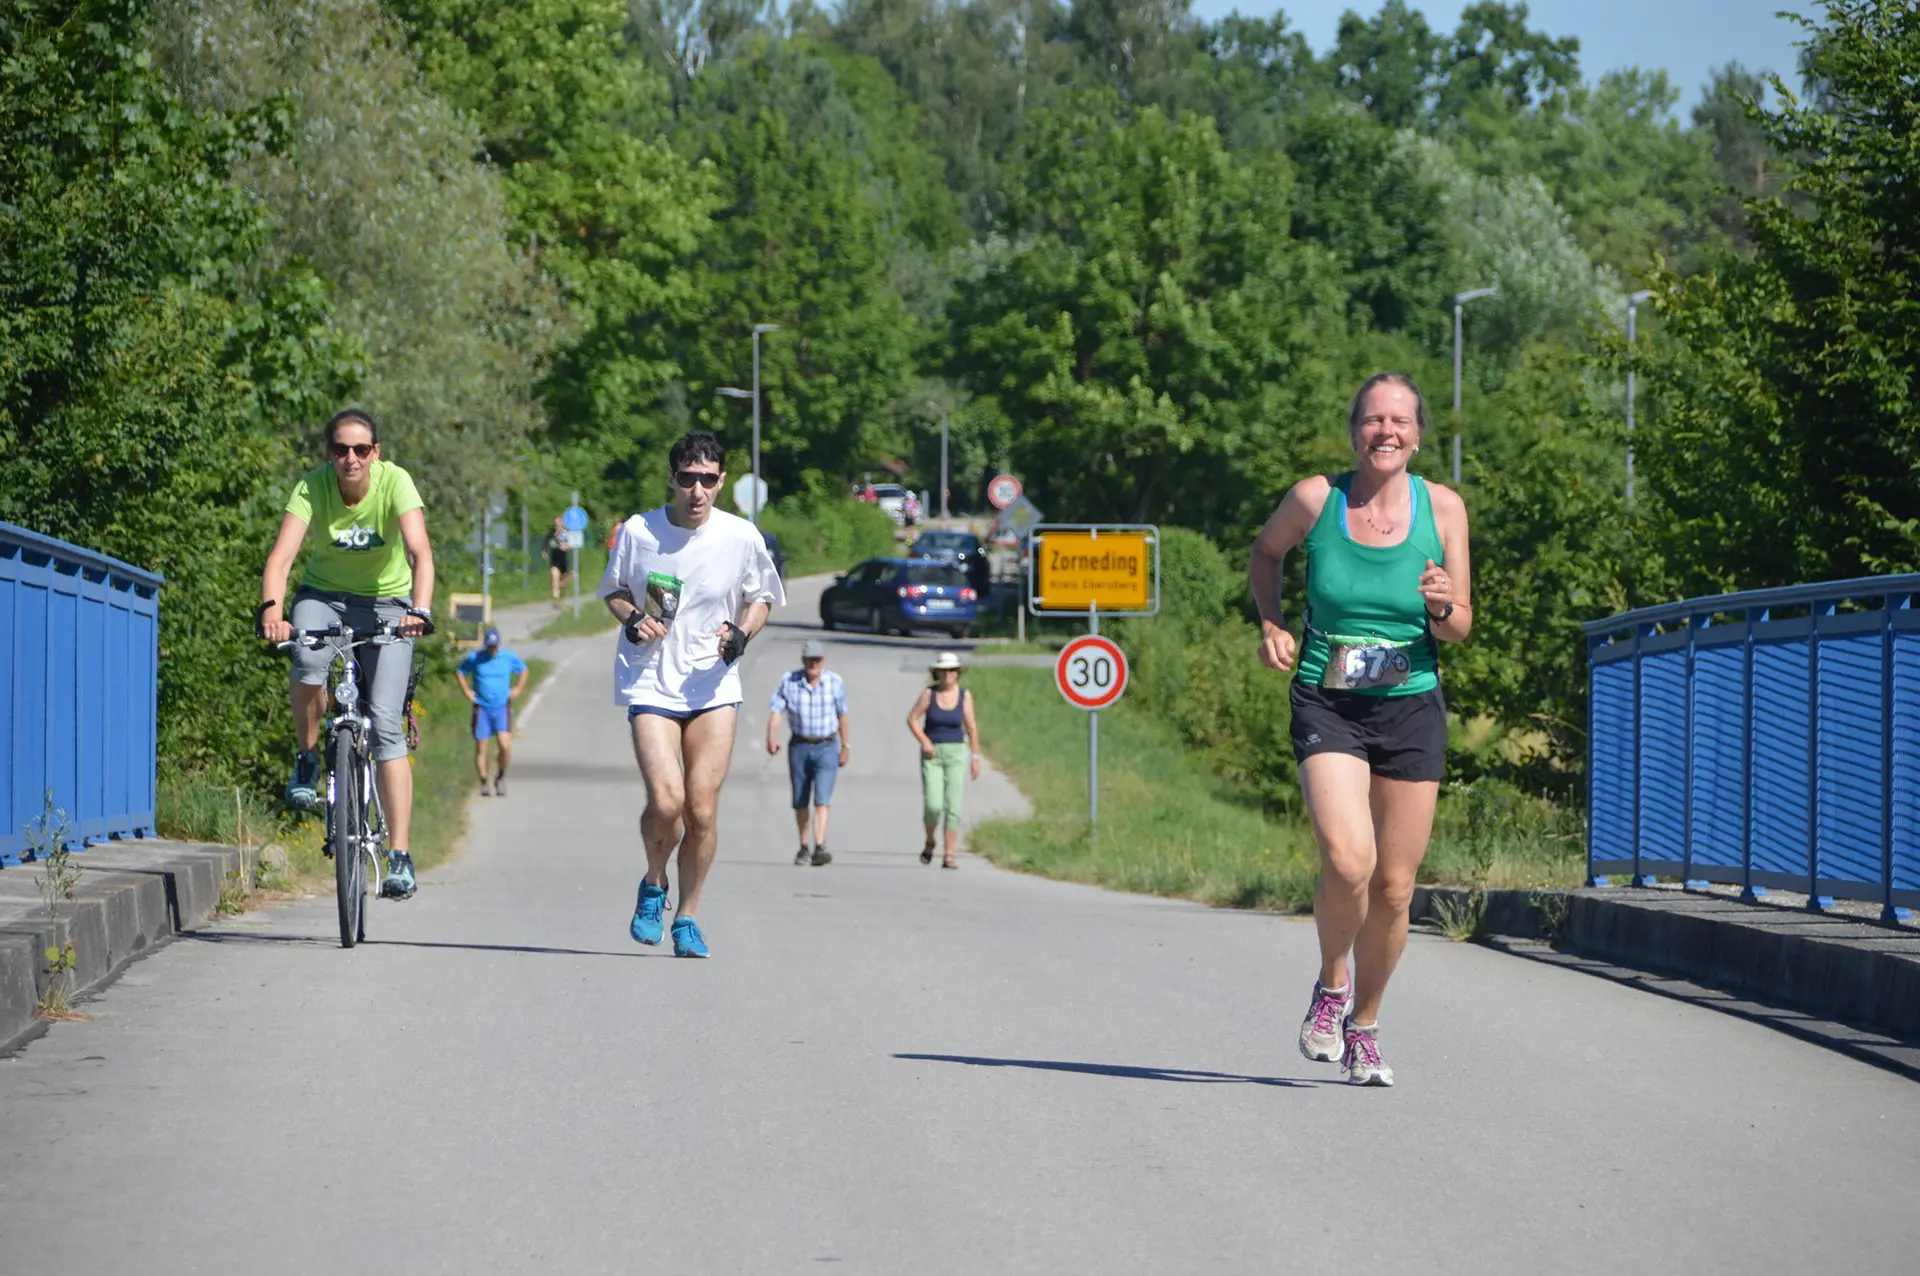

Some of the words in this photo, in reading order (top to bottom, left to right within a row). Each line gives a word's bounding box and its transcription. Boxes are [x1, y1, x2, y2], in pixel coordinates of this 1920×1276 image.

[1050, 549, 1138, 575] Zorneding
[1072, 657, 1110, 687] 30
[1346, 648, 1386, 678] 67
